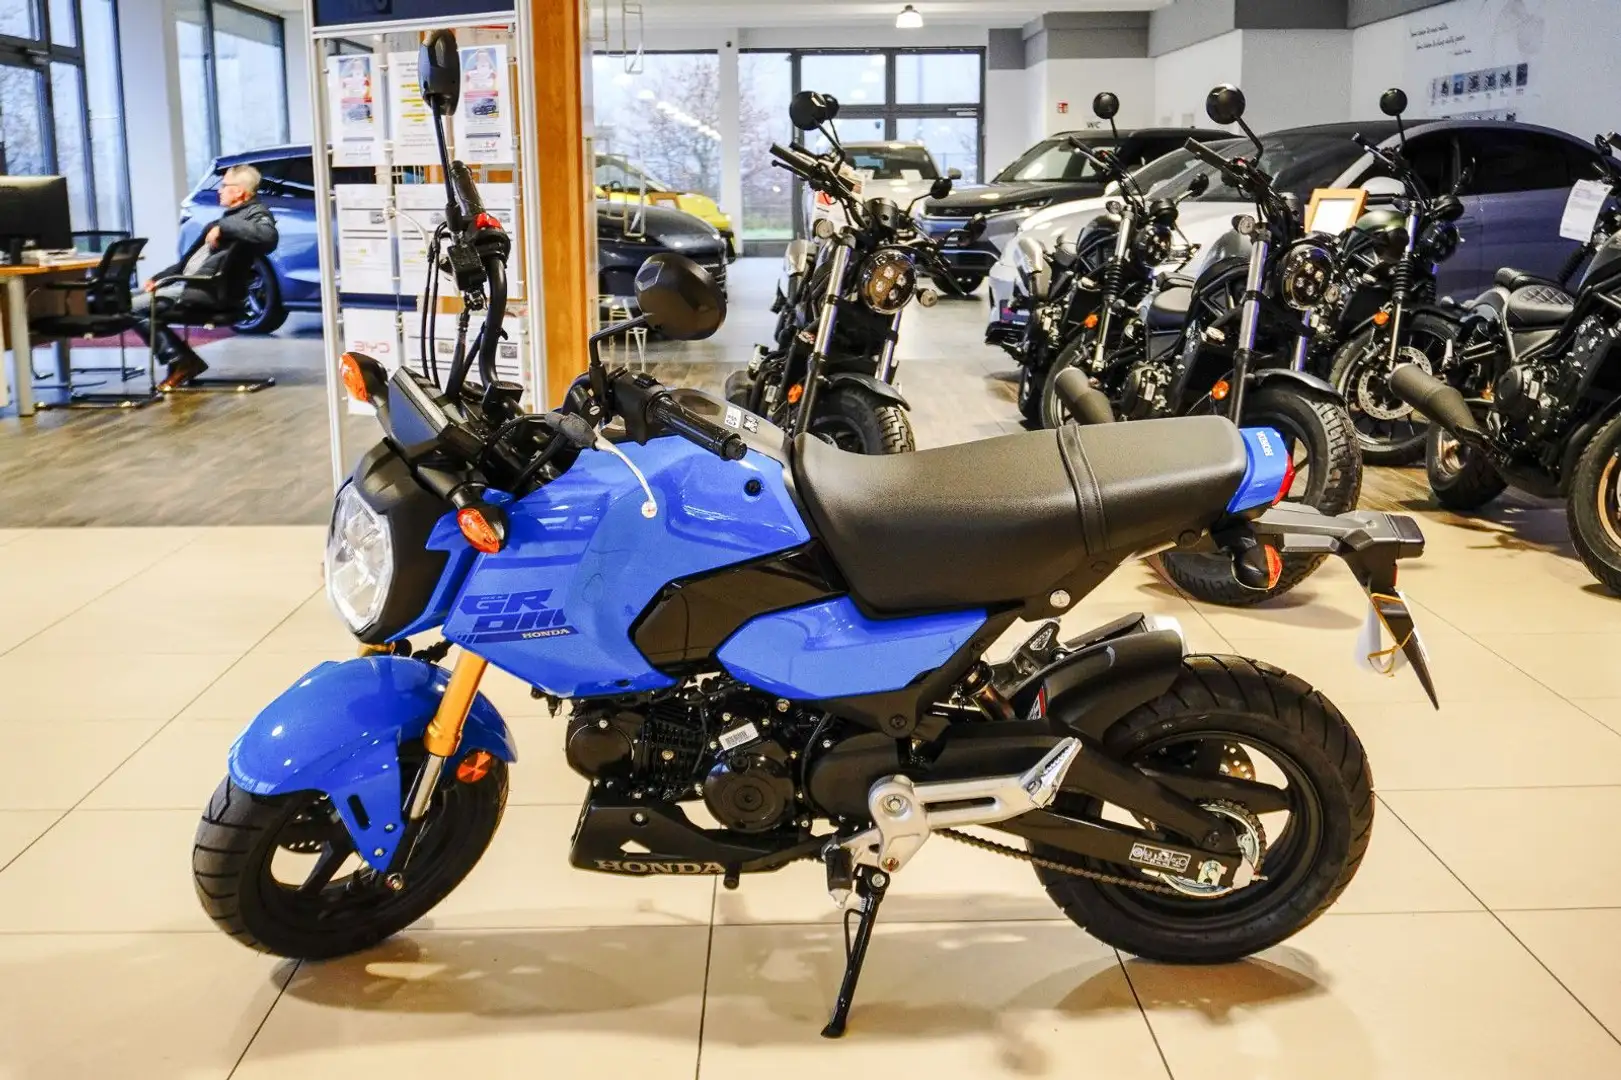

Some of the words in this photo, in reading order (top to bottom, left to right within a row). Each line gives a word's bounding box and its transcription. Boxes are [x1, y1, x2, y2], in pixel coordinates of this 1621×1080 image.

[354, 341, 390, 353] BYD
[1256, 431, 1273, 456] HONDA
[520, 628, 570, 639] HONDA
[593, 859, 726, 874] HONDA
